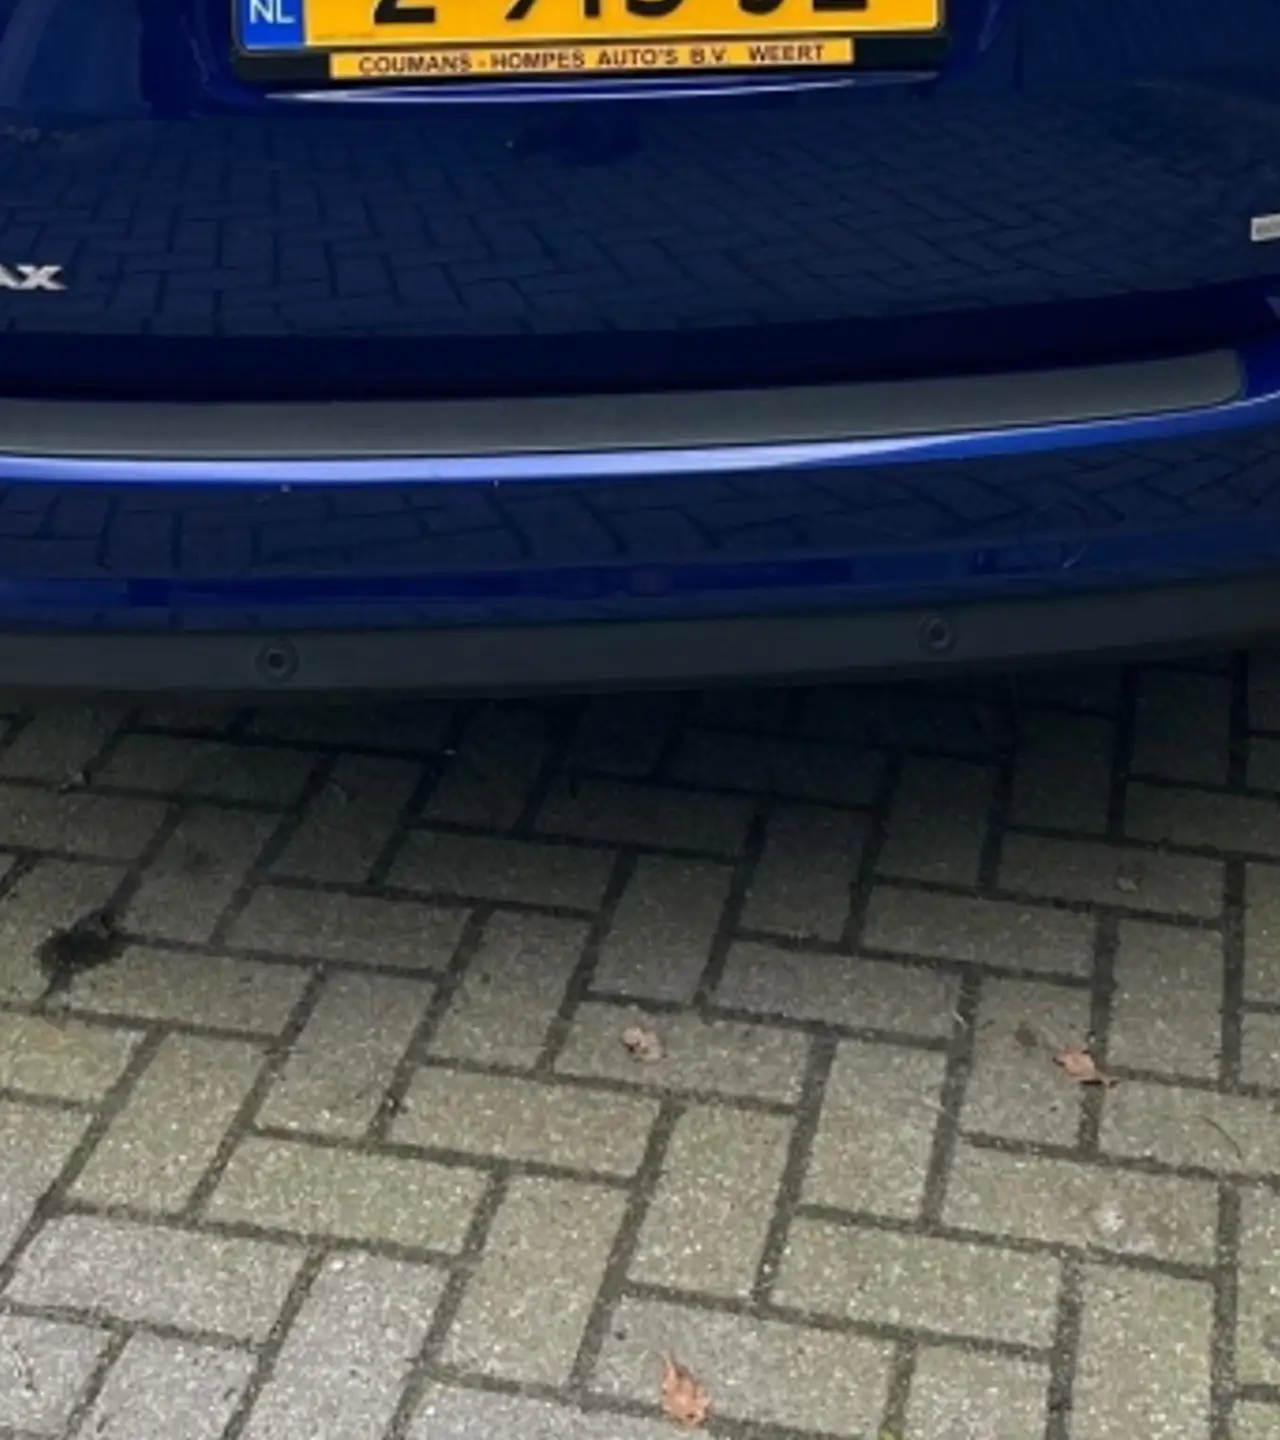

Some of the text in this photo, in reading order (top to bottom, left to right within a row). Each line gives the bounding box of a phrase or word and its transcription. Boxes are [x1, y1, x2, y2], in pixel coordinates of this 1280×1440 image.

[358, 55, 472, 75] COUMANS
[489, 50, 586, 71] HOMPES
[597, 47, 678, 67] AUTO'S
[747, 44, 826, 62] WEERT
